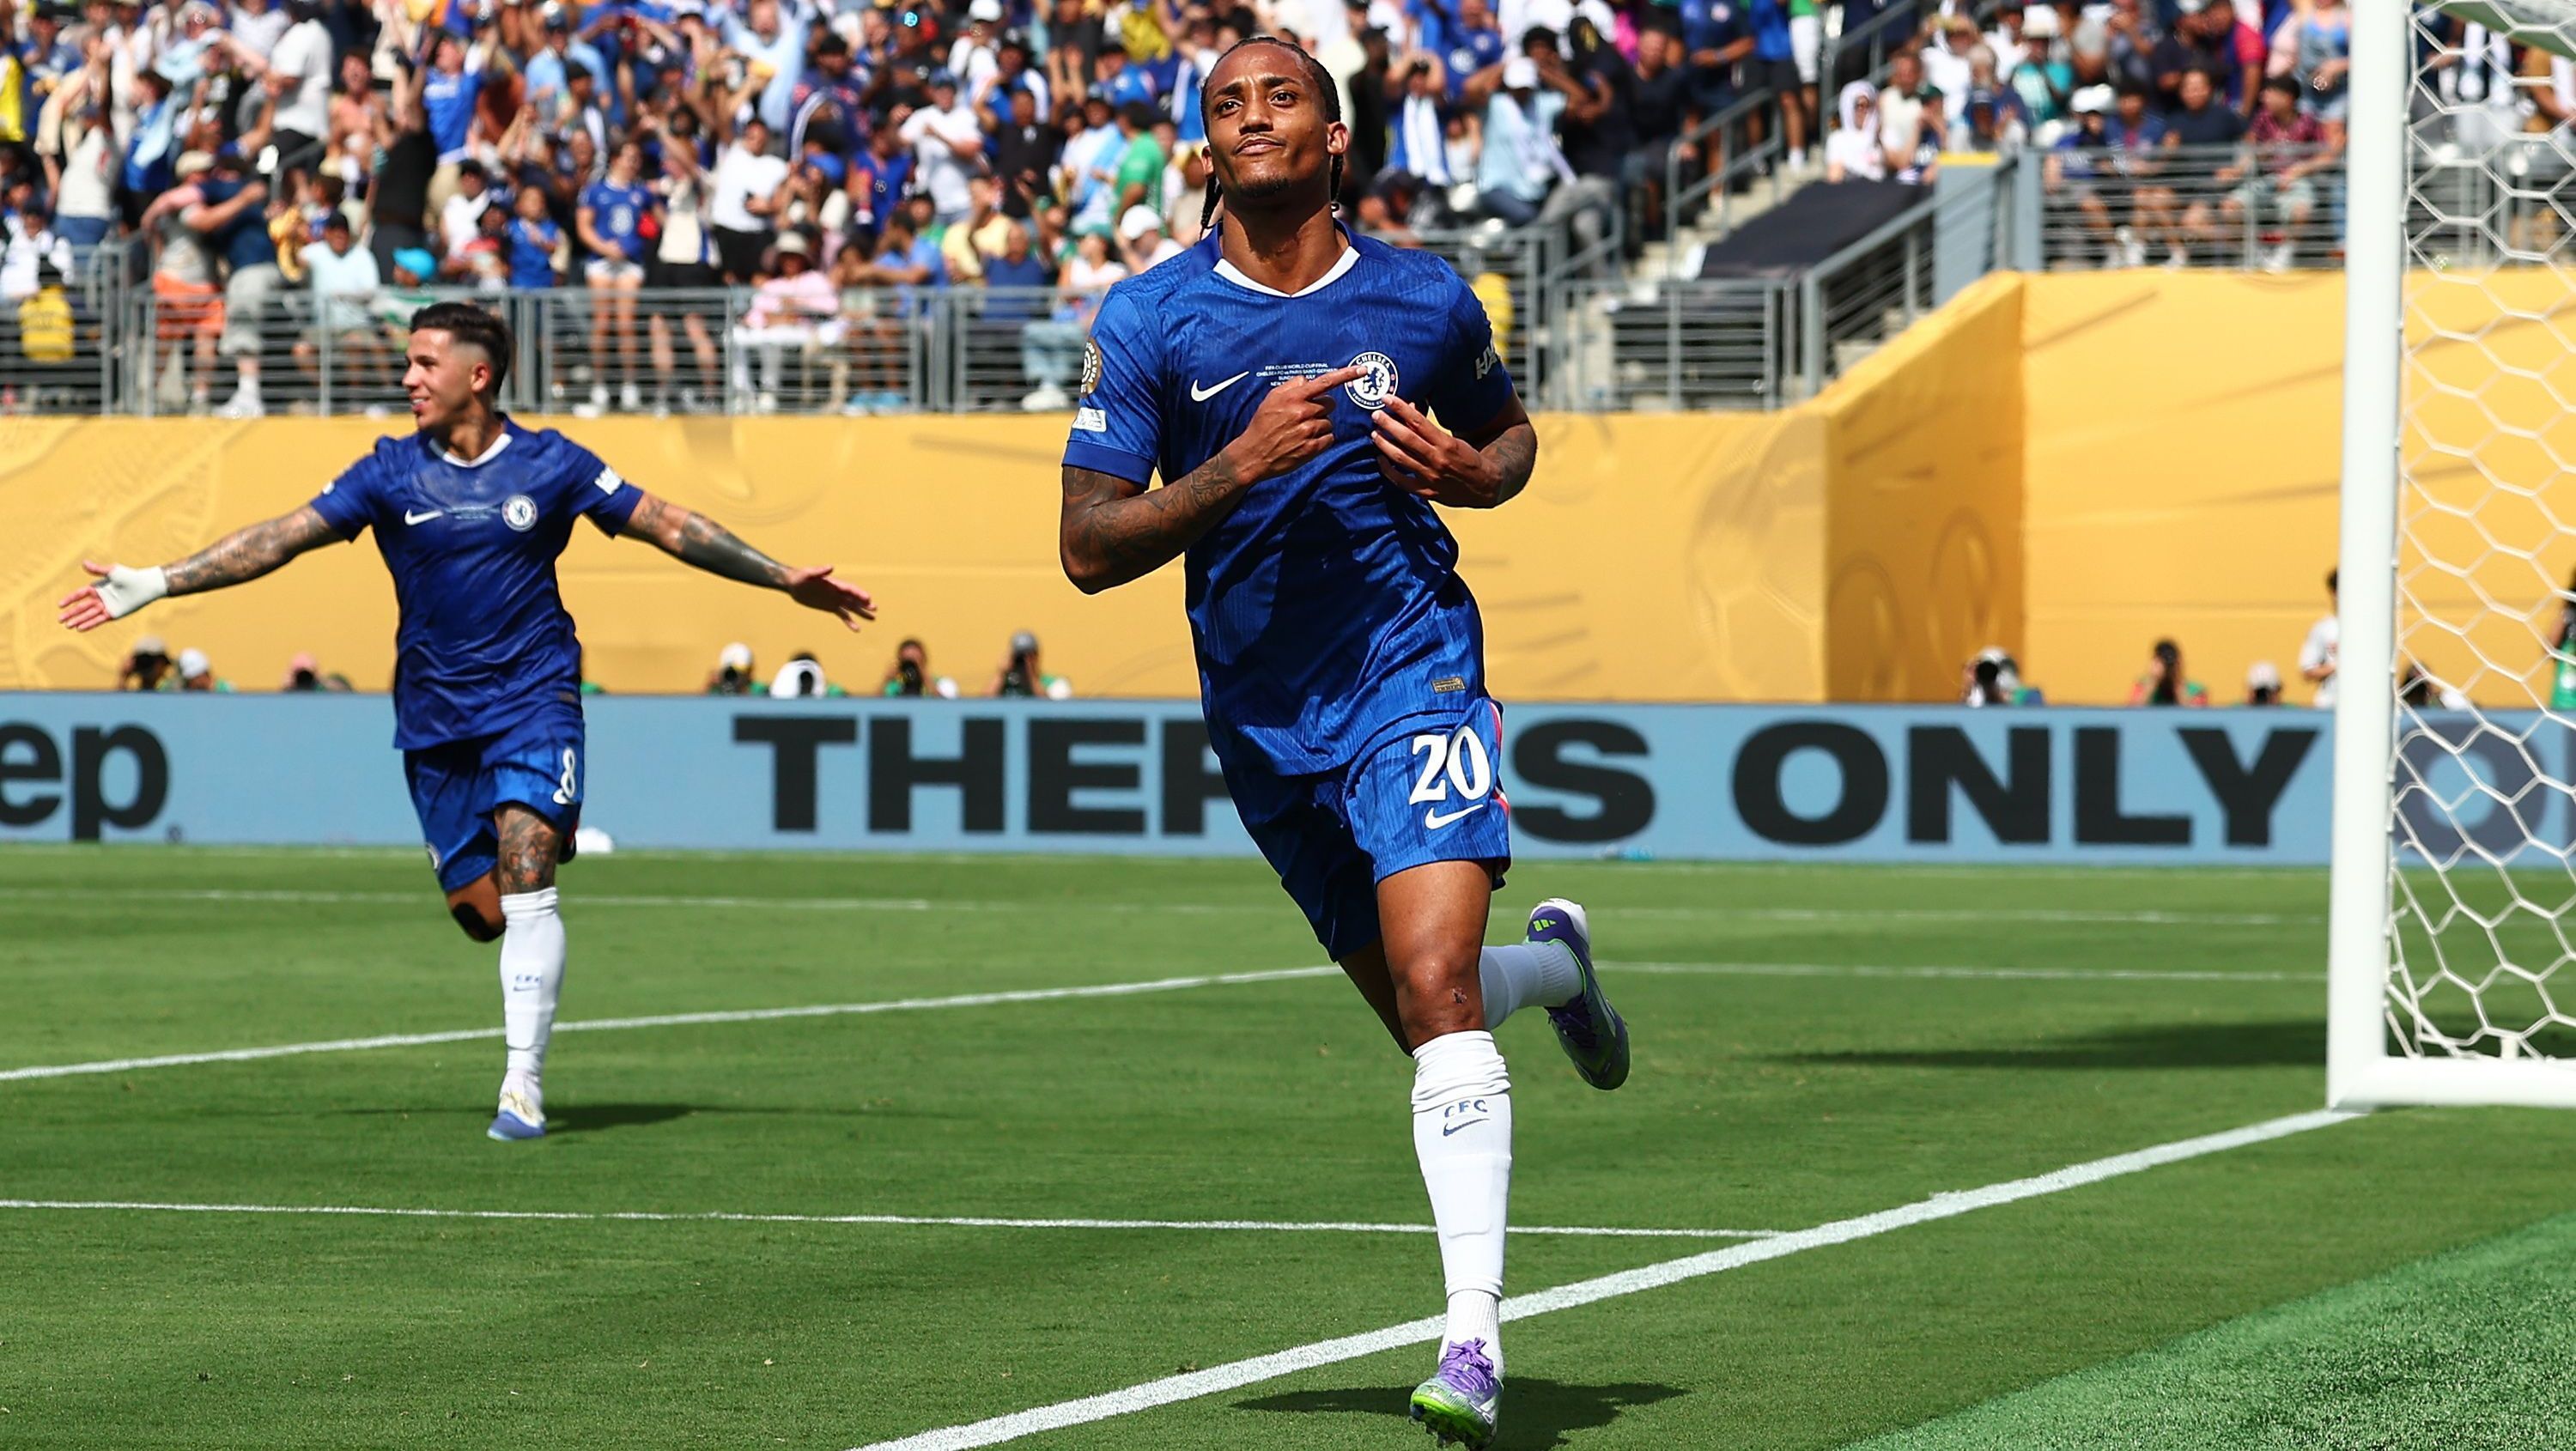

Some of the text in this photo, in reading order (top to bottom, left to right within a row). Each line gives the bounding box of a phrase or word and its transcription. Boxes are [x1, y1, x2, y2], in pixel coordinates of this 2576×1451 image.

[1356, 354, 1390, 368] CHELSEA
[560, 746, 575, 798] 8
[733, 716, 1236, 836] THE
[1510, 719, 1656, 844] S
[1732, 720, 2321, 847] ONLY
[1409, 726, 1491, 805] 20
[1444, 1100, 1488, 1118] CFC
